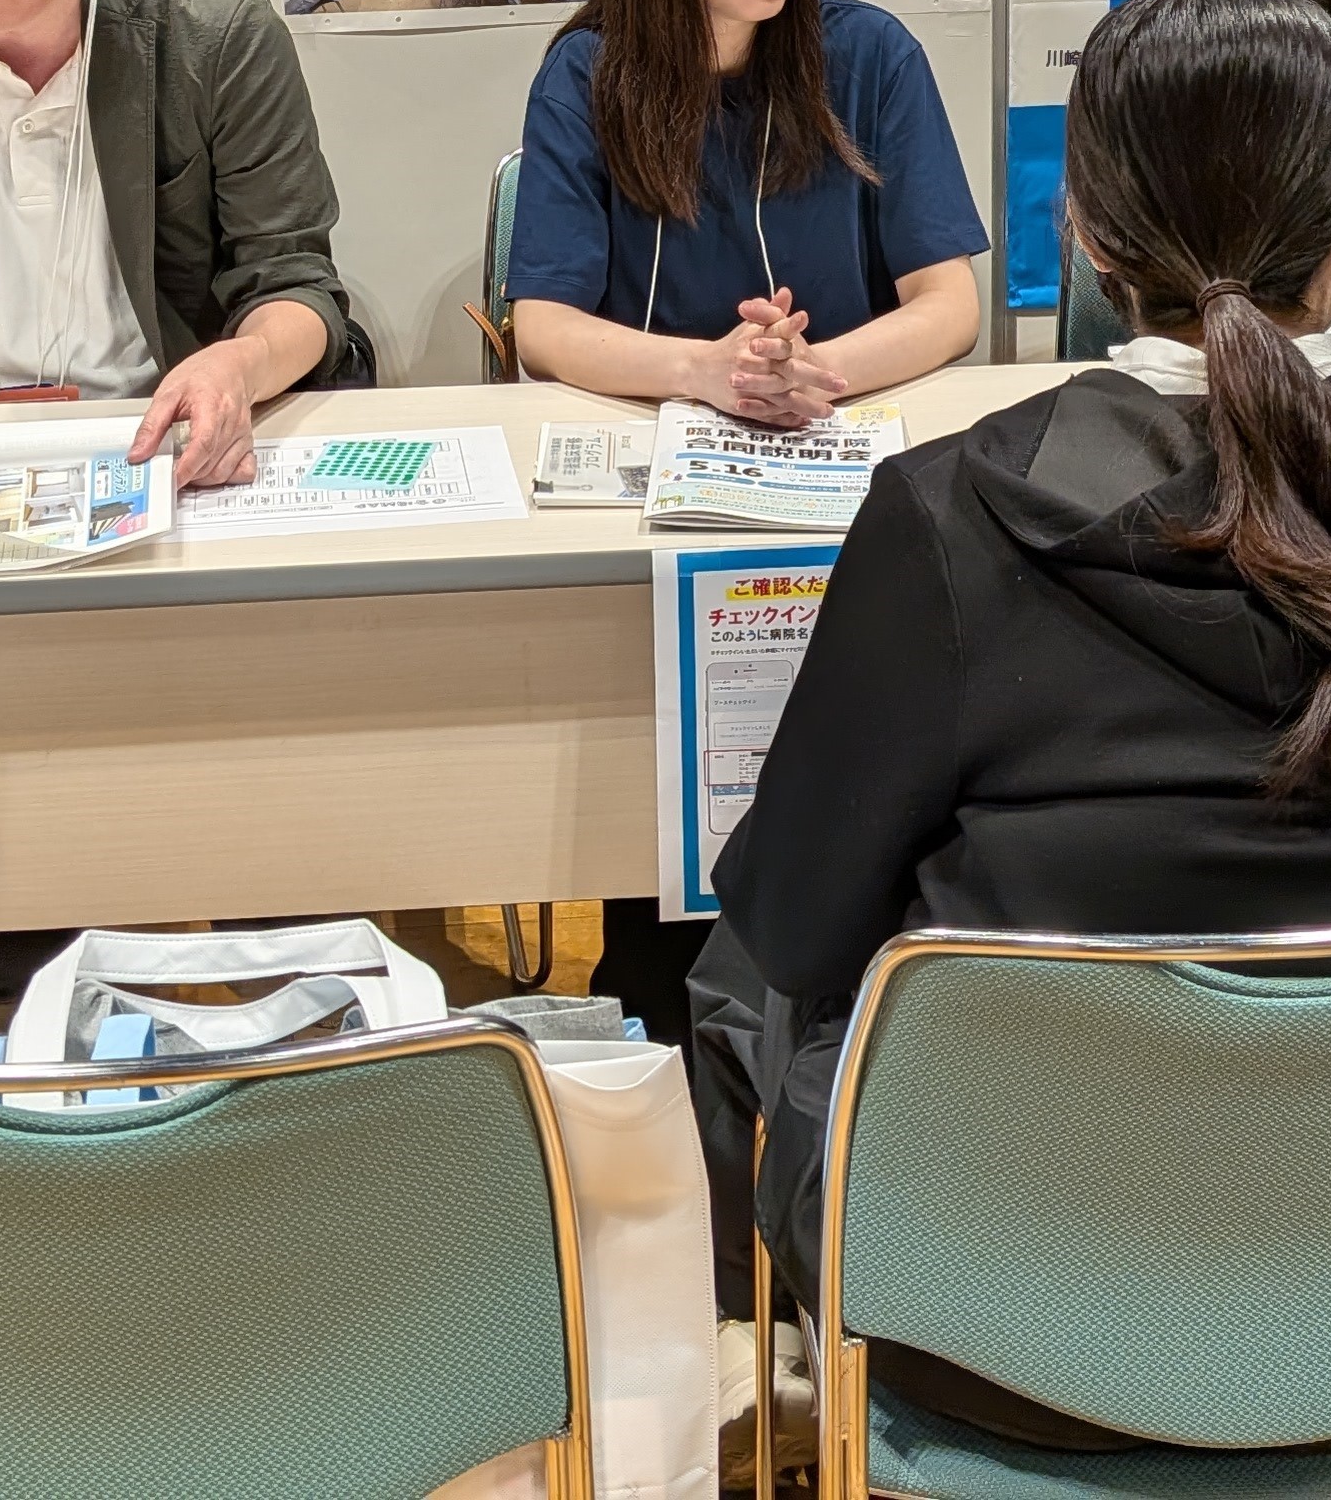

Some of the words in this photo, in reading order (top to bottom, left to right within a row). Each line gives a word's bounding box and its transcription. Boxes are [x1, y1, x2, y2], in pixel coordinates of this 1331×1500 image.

[686, 426, 871, 448] 臨床研修病院
[684, 437, 872, 462] 合同説明会
[688, 460, 764, 478] 5.16
[708, 604, 821, 628] チェックイン
[710, 627, 814, 643] このように病院名
